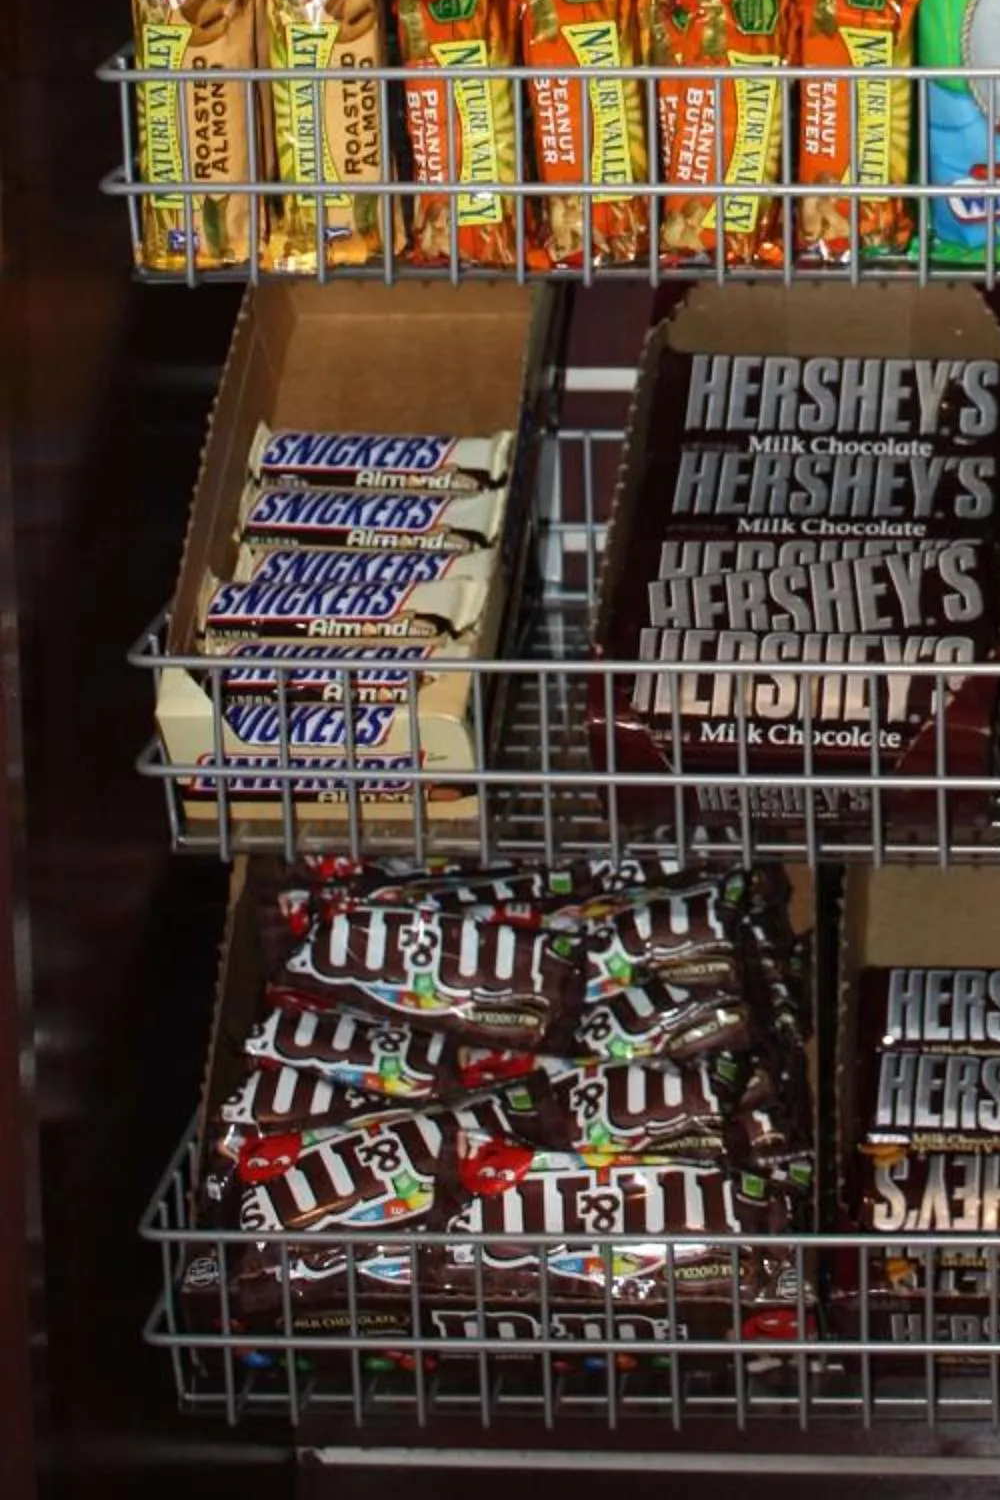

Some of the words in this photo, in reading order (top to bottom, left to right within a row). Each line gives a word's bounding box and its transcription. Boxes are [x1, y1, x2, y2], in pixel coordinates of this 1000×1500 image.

[147, 27, 183, 108] VALEY
[292, 28, 331, 106] VALEY
[847, 32, 890, 117] NAURE
[343, 51, 362, 176] ROASTD
[571, 27, 620, 118] NAURE
[602, 119, 629, 185] VALLE
[676, 87, 704, 181] BUTTER
[805, 80, 821, 155] UTTER
[821, 78, 838, 158] EANUT
[458, 136, 497, 220] VALEY
[713, 150, 762, 229] VALEY
[860, 118, 888, 185] VALLE
[685, 355, 999, 437] HERSHEY'S
[262, 434, 450, 469] SNICKERS
[672, 450, 996, 519] HERSHEY'S
[748, 435, 806, 455] Milk
[809, 436, 934, 458] Chocolate
[252, 492, 444, 530] SNICKERS
[736, 518, 797, 535] Milk
[801, 518, 928, 537] Chocolate
[208, 582, 405, 617] SNICKERS
[256, 551, 451, 583] SNICKERS
[648, 543, 987, 632] HERSHEY'S
[224, 706, 396, 746] NICKERS
[700, 722, 763, 744] Mik
